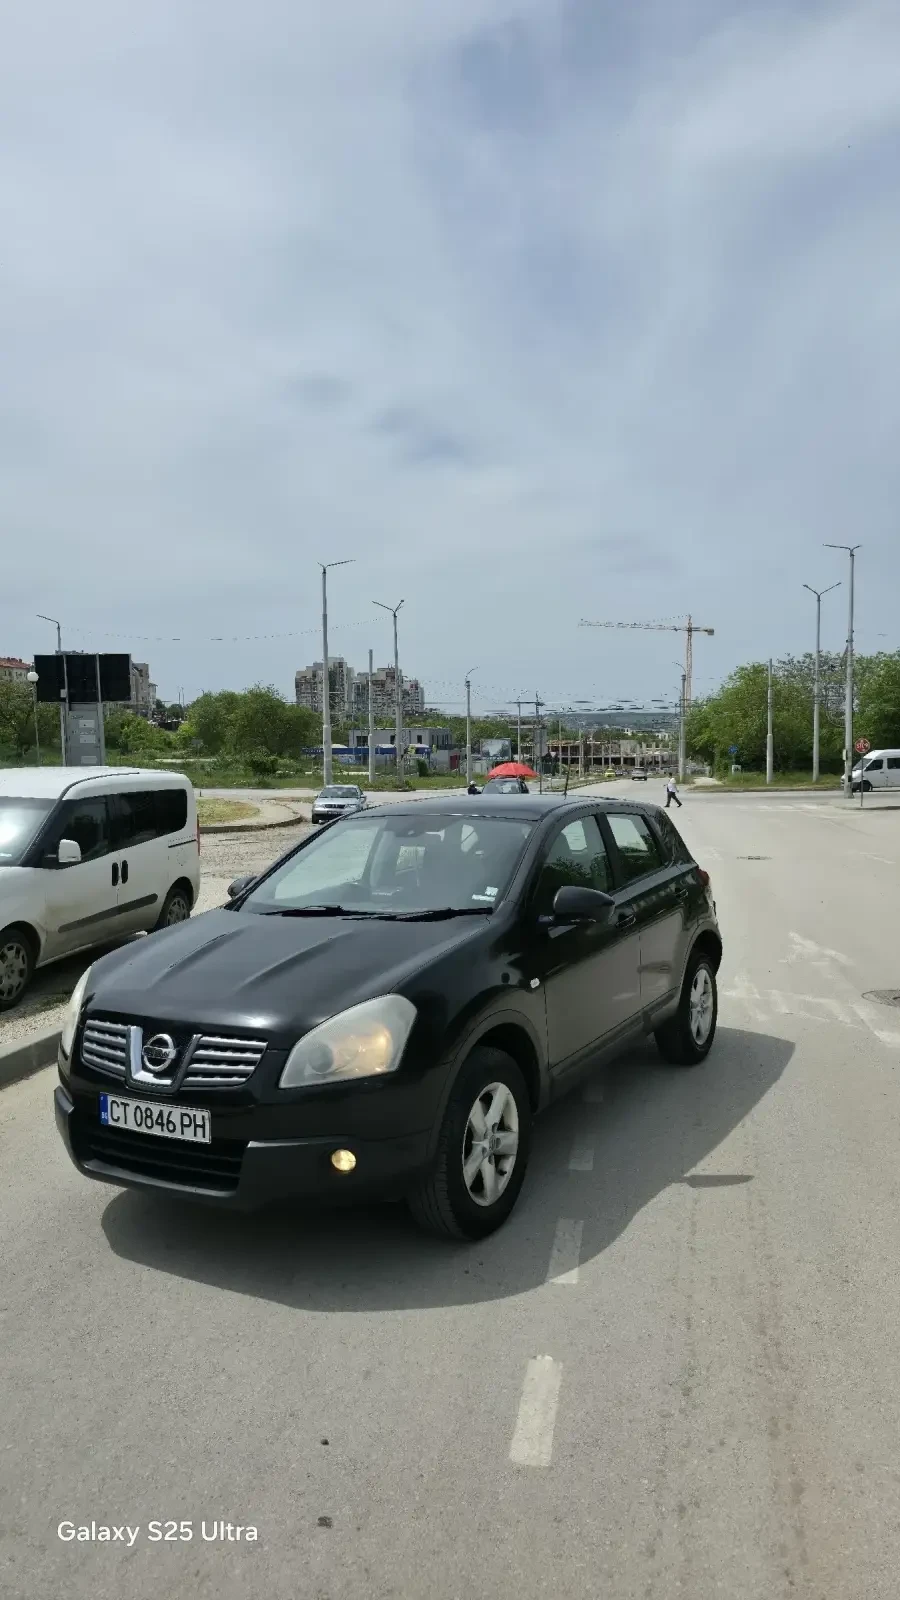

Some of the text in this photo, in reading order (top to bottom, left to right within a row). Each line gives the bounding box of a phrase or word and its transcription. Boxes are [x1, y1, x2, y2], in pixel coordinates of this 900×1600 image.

[110, 1100, 206, 1138] CT 0846 PH
